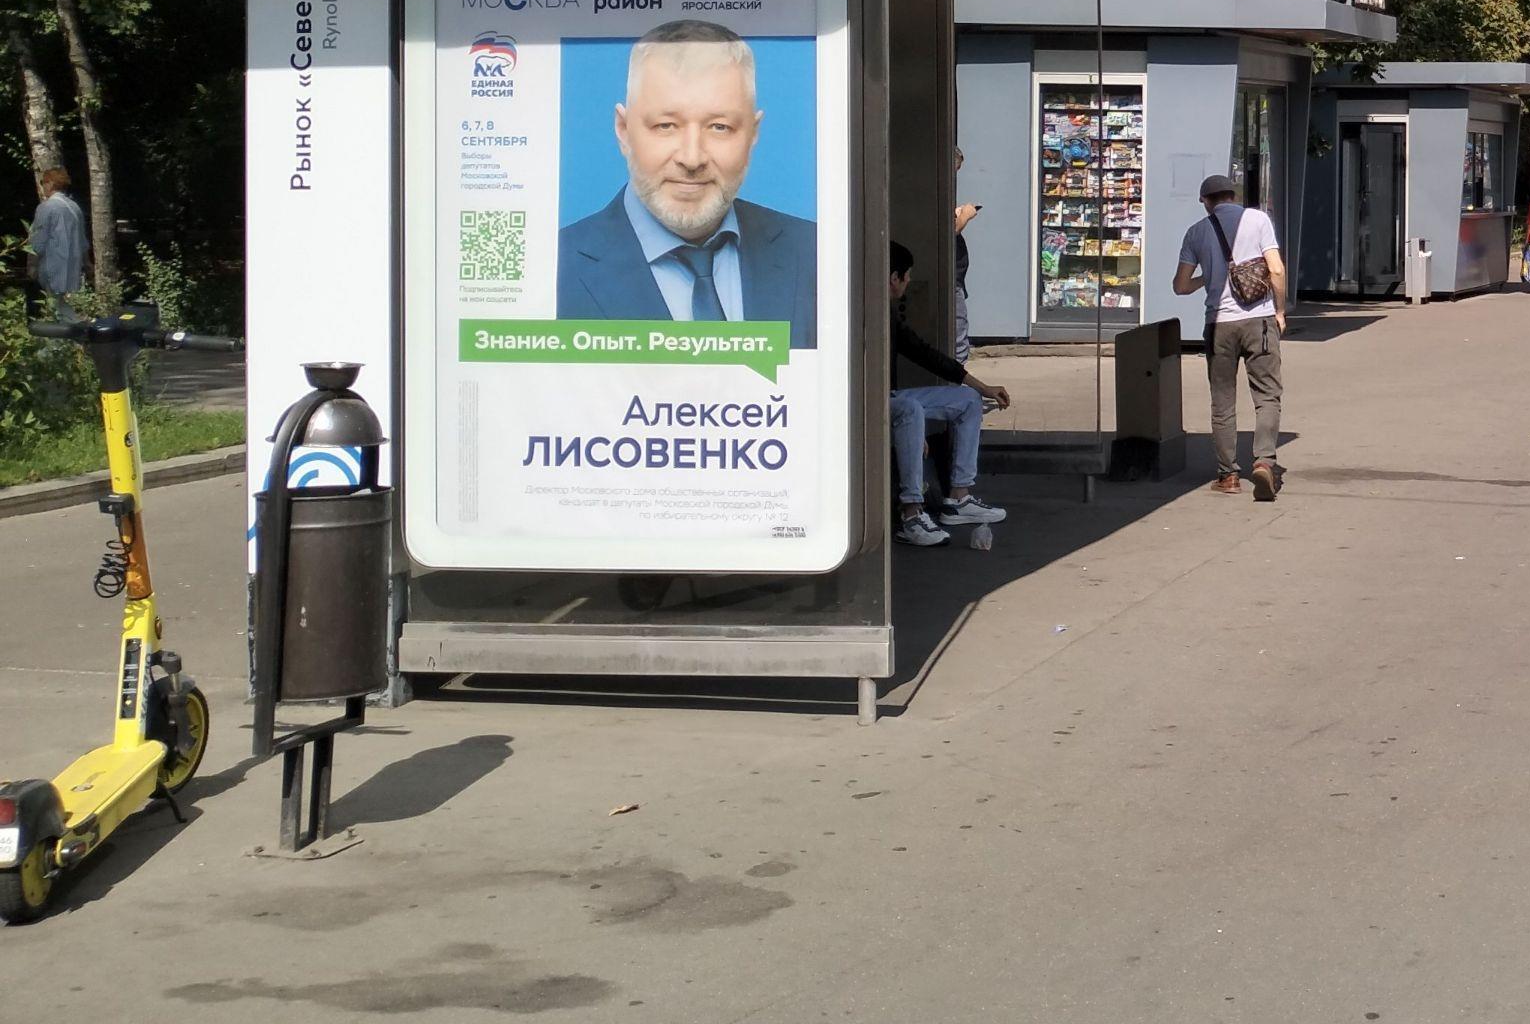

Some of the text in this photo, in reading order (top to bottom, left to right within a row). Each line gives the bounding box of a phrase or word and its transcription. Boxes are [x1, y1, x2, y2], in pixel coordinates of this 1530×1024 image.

[471, 79, 513, 89] ЕДИНАЯ
[471, 89, 513, 98] РОССИЯ
[461, 120, 495, 131] 6, 7, 8
[290, 97, 311, 190] Рынок
[461, 136, 528, 146] СЕНТЯБРЯ
[474, 330, 773, 356] Знание. Опыт. Результат.
[622, 395, 788, 427] Алексей
[523, 435, 788, 471] ЛИСОВЕНКО
